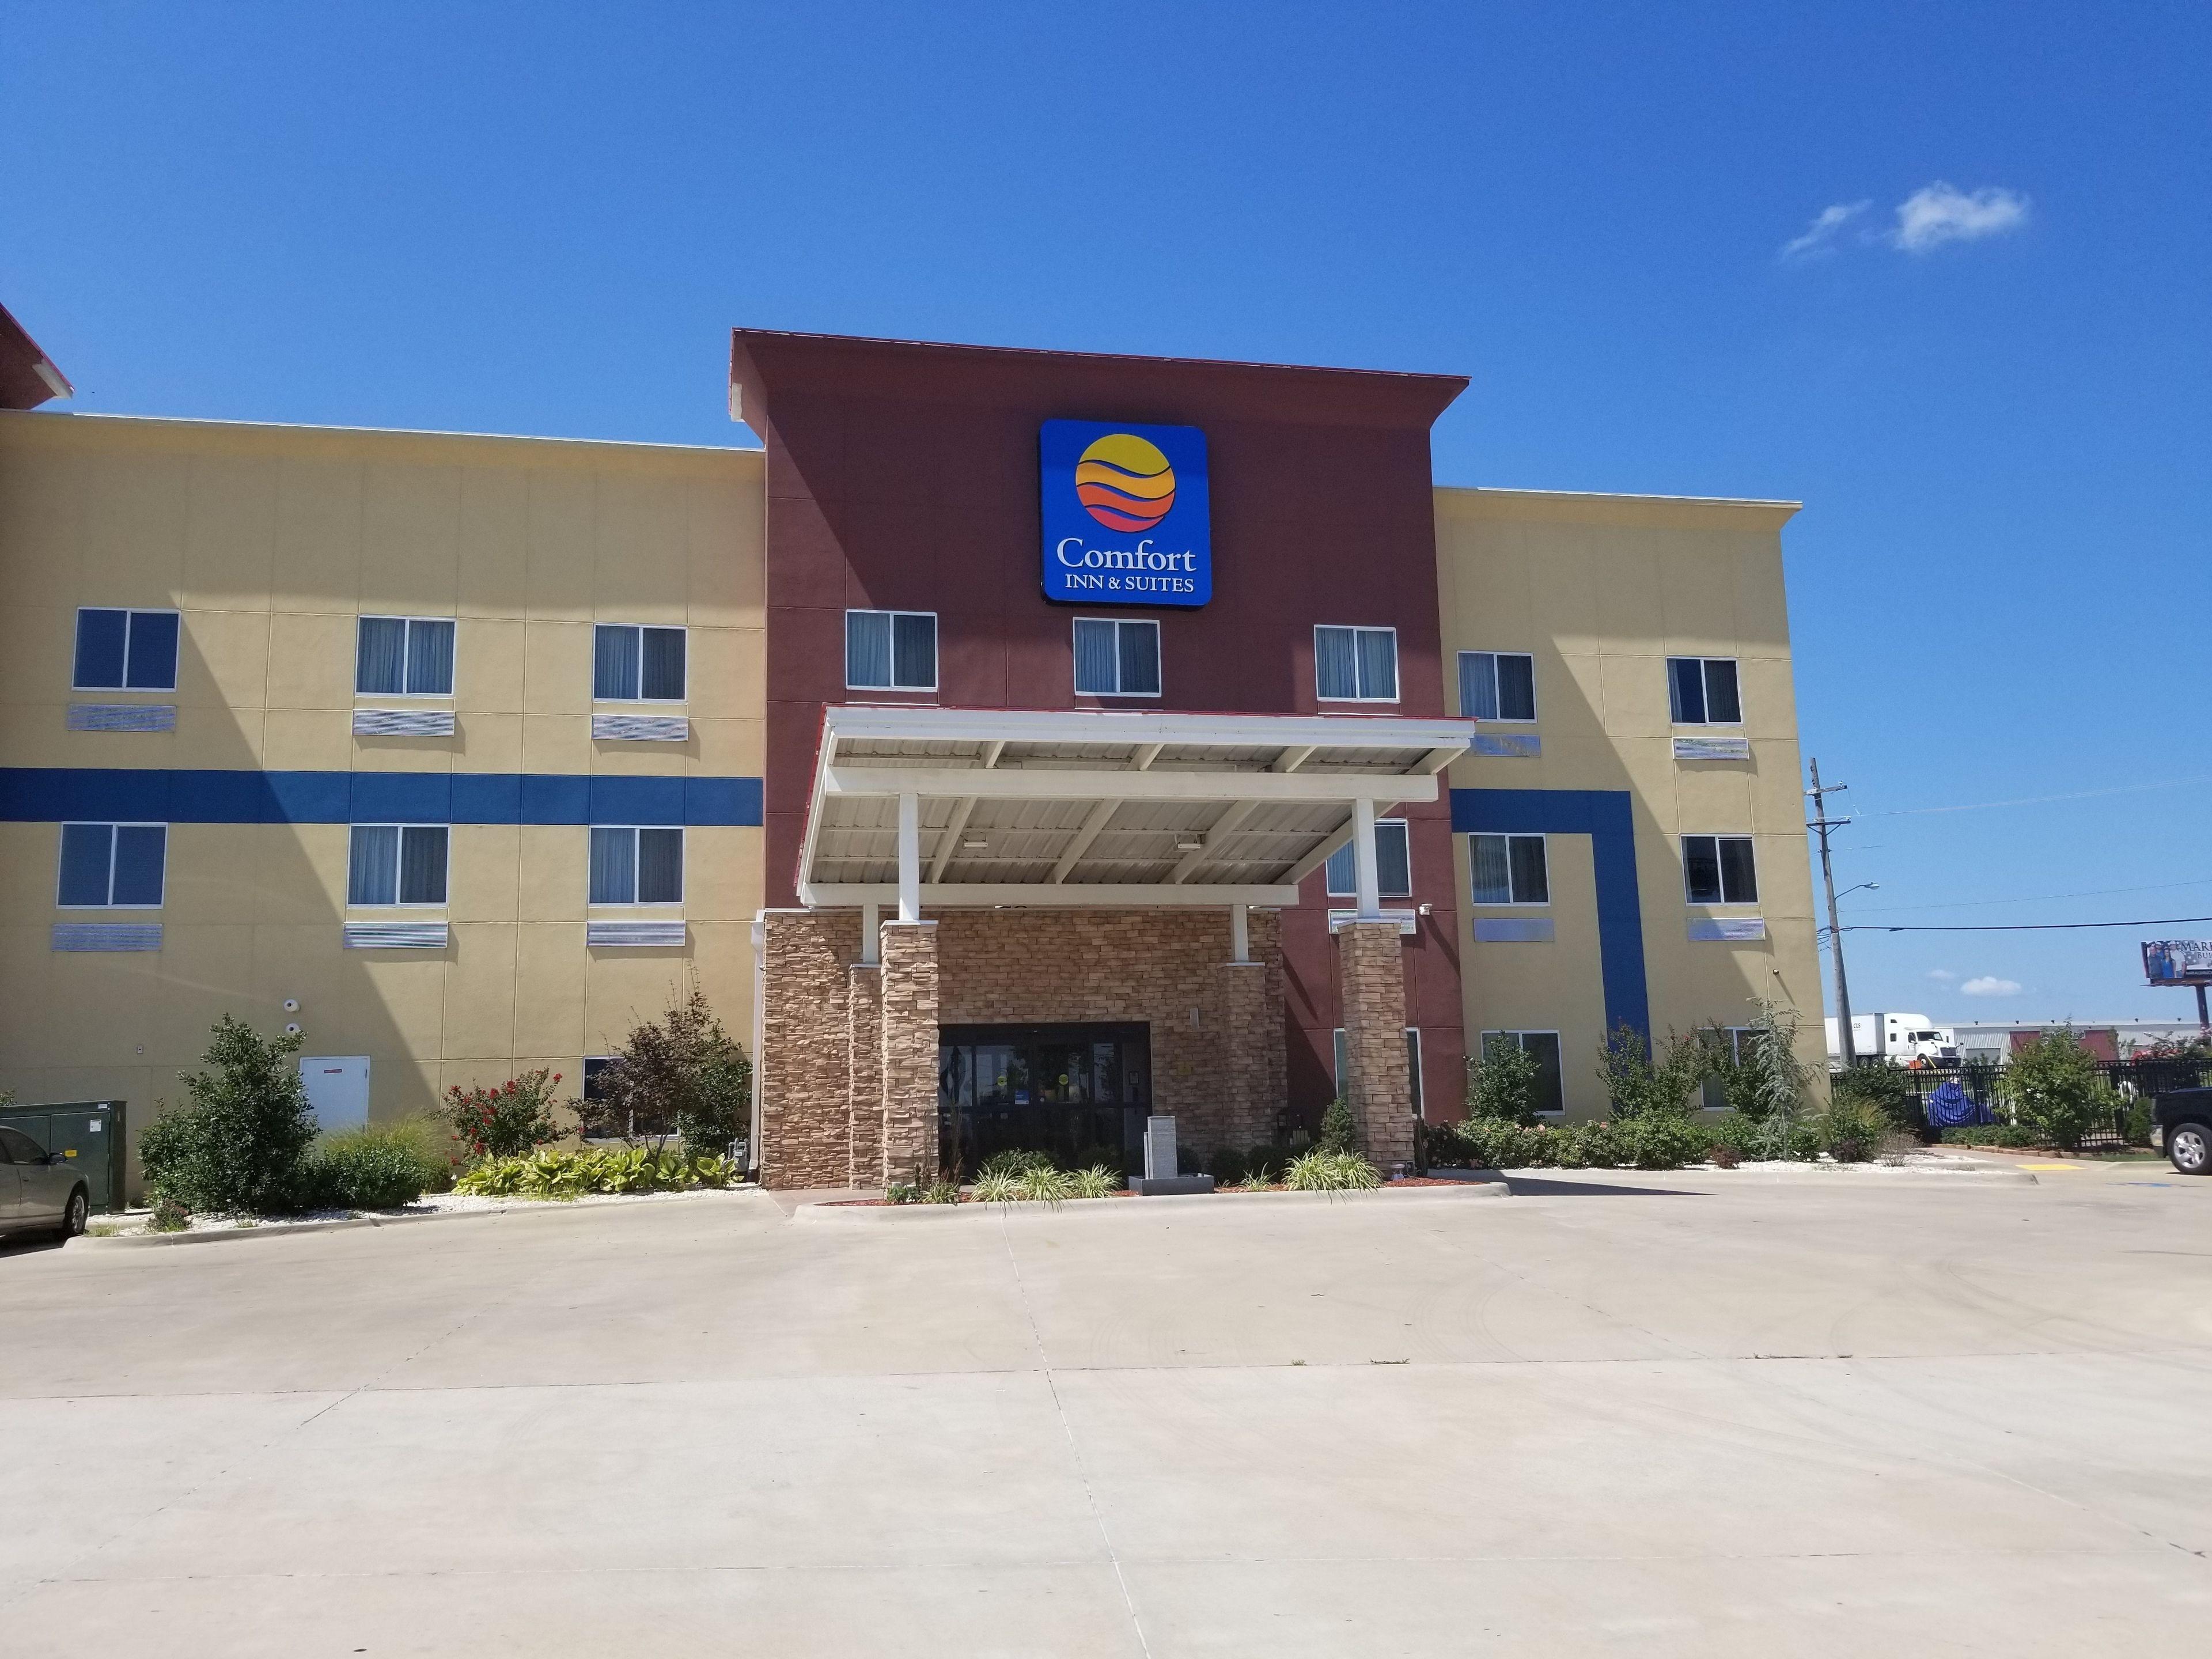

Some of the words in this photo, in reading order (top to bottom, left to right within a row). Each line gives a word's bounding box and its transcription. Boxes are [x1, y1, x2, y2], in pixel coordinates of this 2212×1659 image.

[1056, 537, 1197, 571] Comfort
[1065, 574, 1104, 589] INN
[1108, 577, 1121, 590] &
[1125, 576, 1194, 593] SUITES
